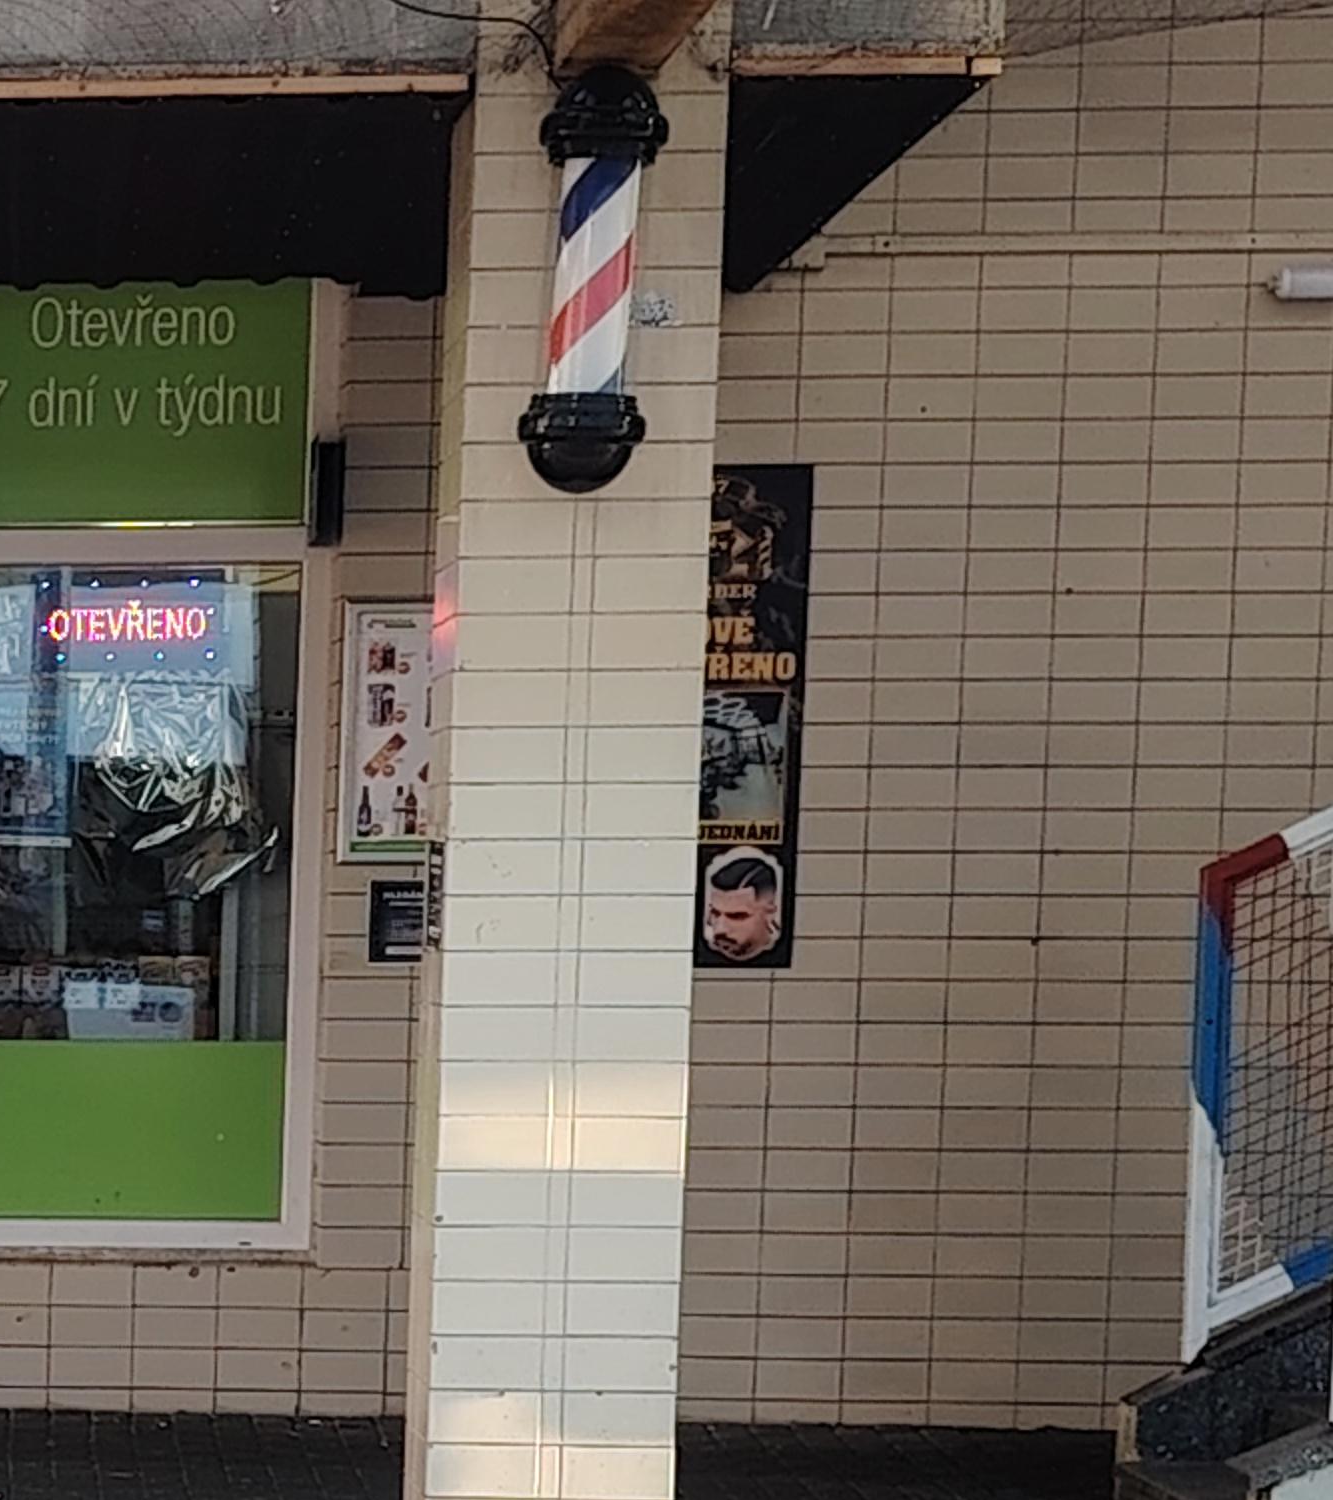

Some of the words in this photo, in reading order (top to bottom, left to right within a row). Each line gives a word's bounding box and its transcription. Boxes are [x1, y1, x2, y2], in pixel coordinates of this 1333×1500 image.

[32, 294, 235, 348] Otevřeno
[28, 373, 100, 428] dní
[114, 387, 139, 427] v
[155, 373, 282, 437] týdnu
[47, 599, 208, 642] OTEVŘENO
[708, 608, 756, 645] VĚ
